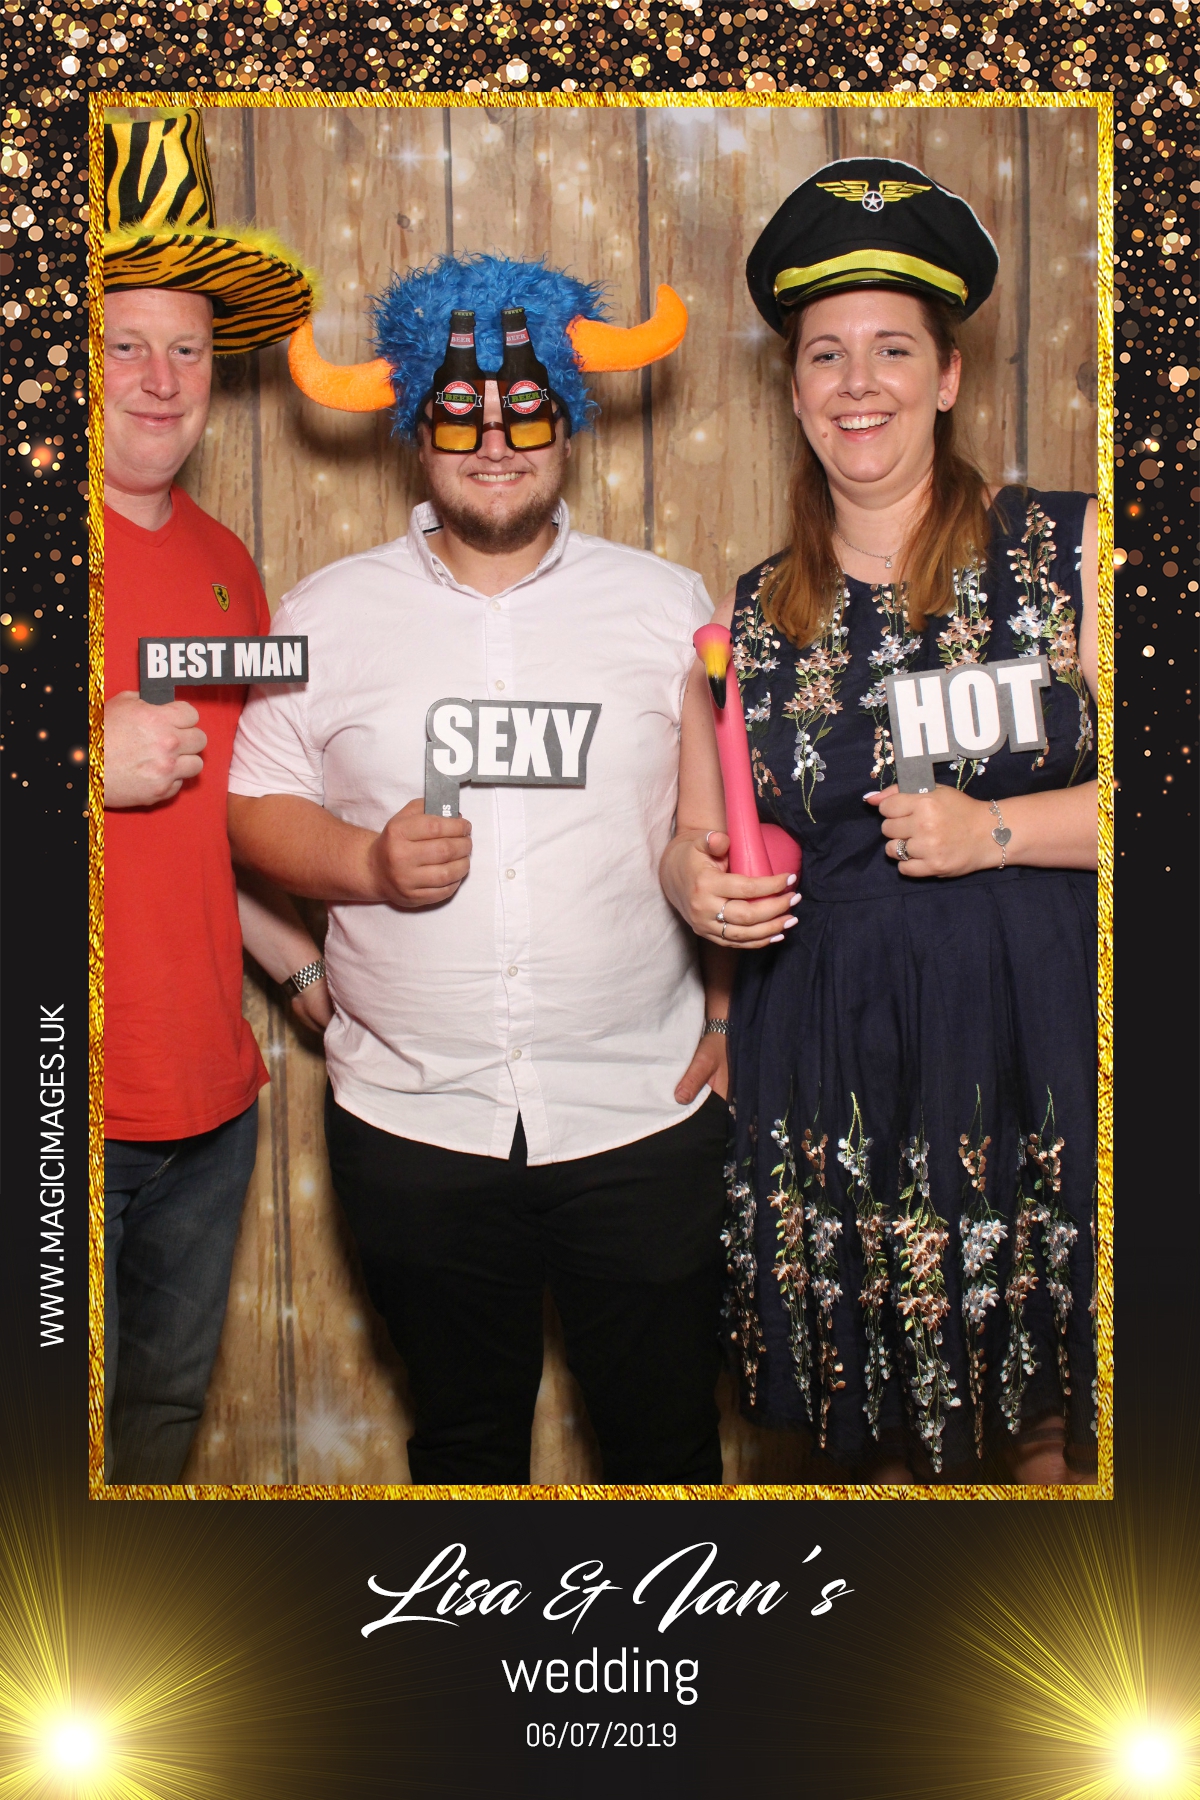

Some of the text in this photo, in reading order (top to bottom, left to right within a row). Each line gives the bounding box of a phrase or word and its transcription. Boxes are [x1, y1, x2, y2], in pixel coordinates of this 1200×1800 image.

[506, 333, 526, 341] BEER
[445, 393, 473, 402] BEER
[511, 391, 540, 403] BEER
[147, 642, 303, 679] BEST MAN
[893, 662, 1043, 759] HOT
[432, 703, 593, 779] SEXY
